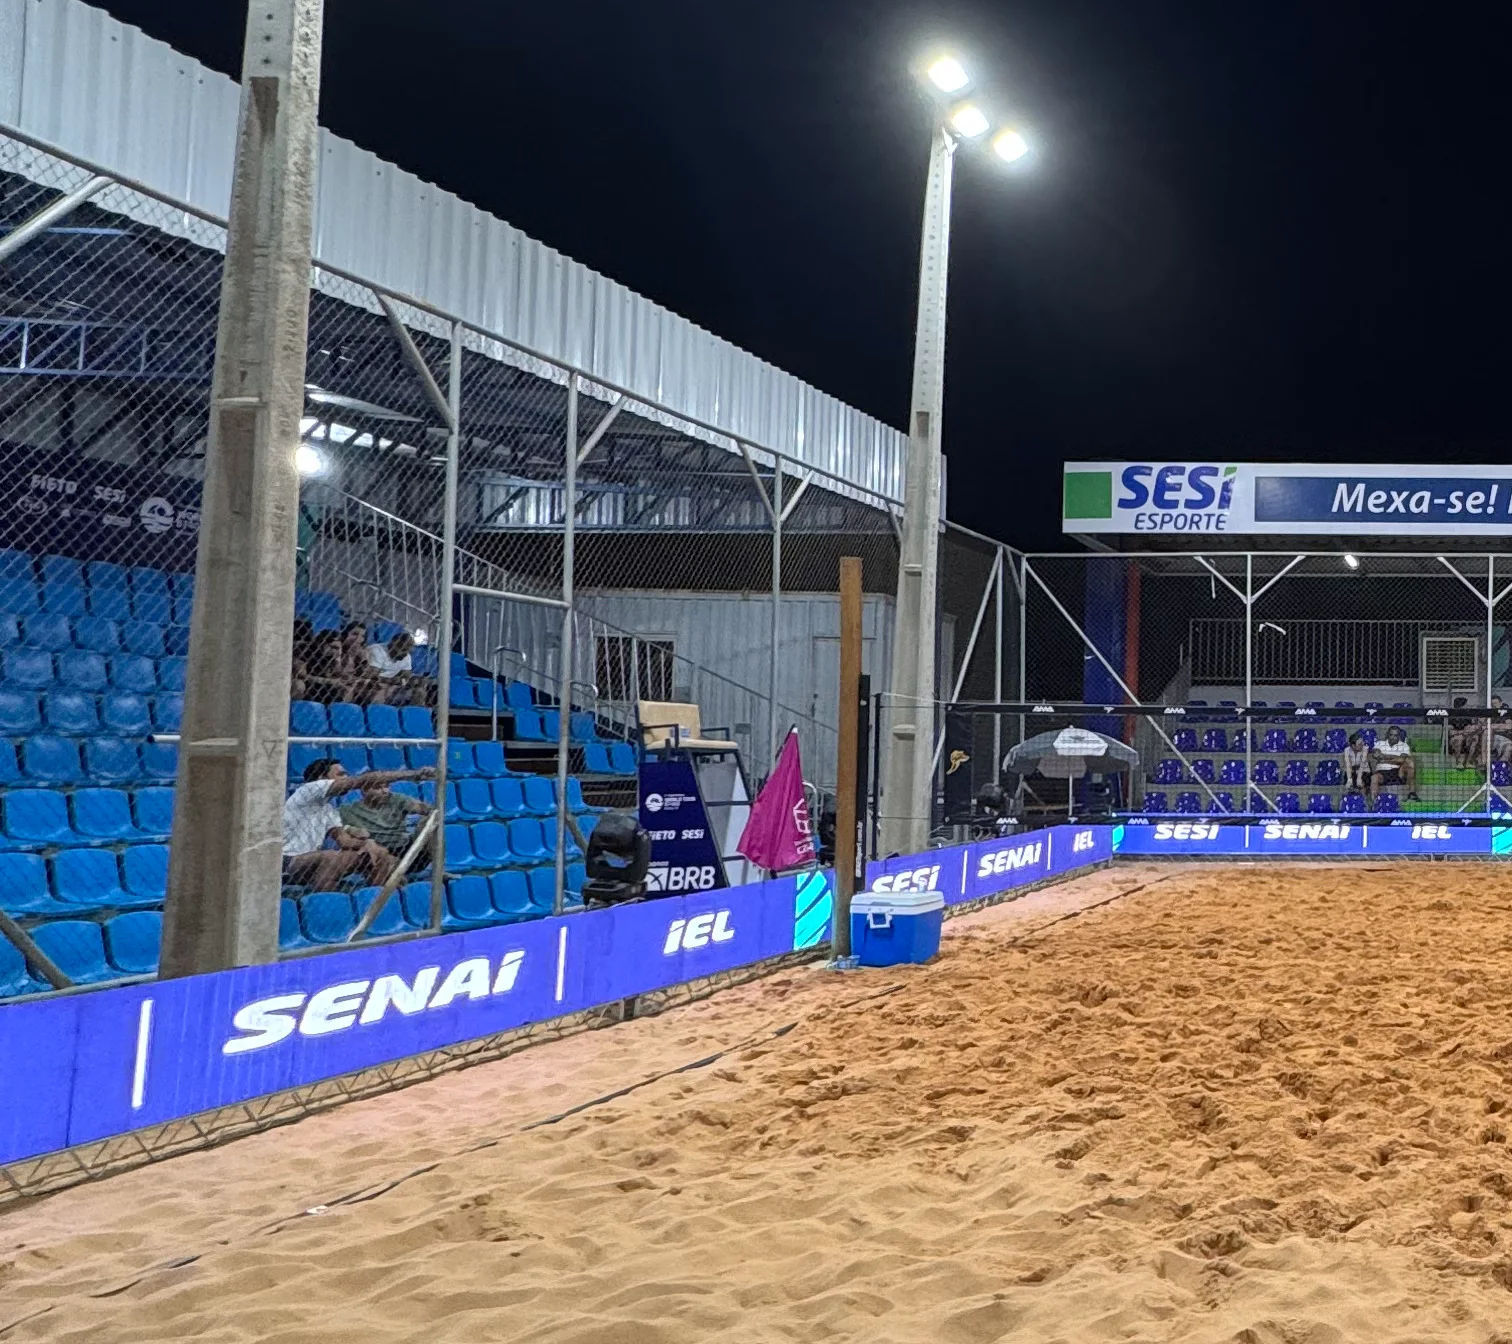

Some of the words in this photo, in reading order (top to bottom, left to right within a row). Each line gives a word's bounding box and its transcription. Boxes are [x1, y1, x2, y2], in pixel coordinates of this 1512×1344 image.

[1331, 482, 1498, 514] Mexa-se!
[1134, 513, 1227, 530] ESPORTE
[668, 866, 715, 890] BRB
